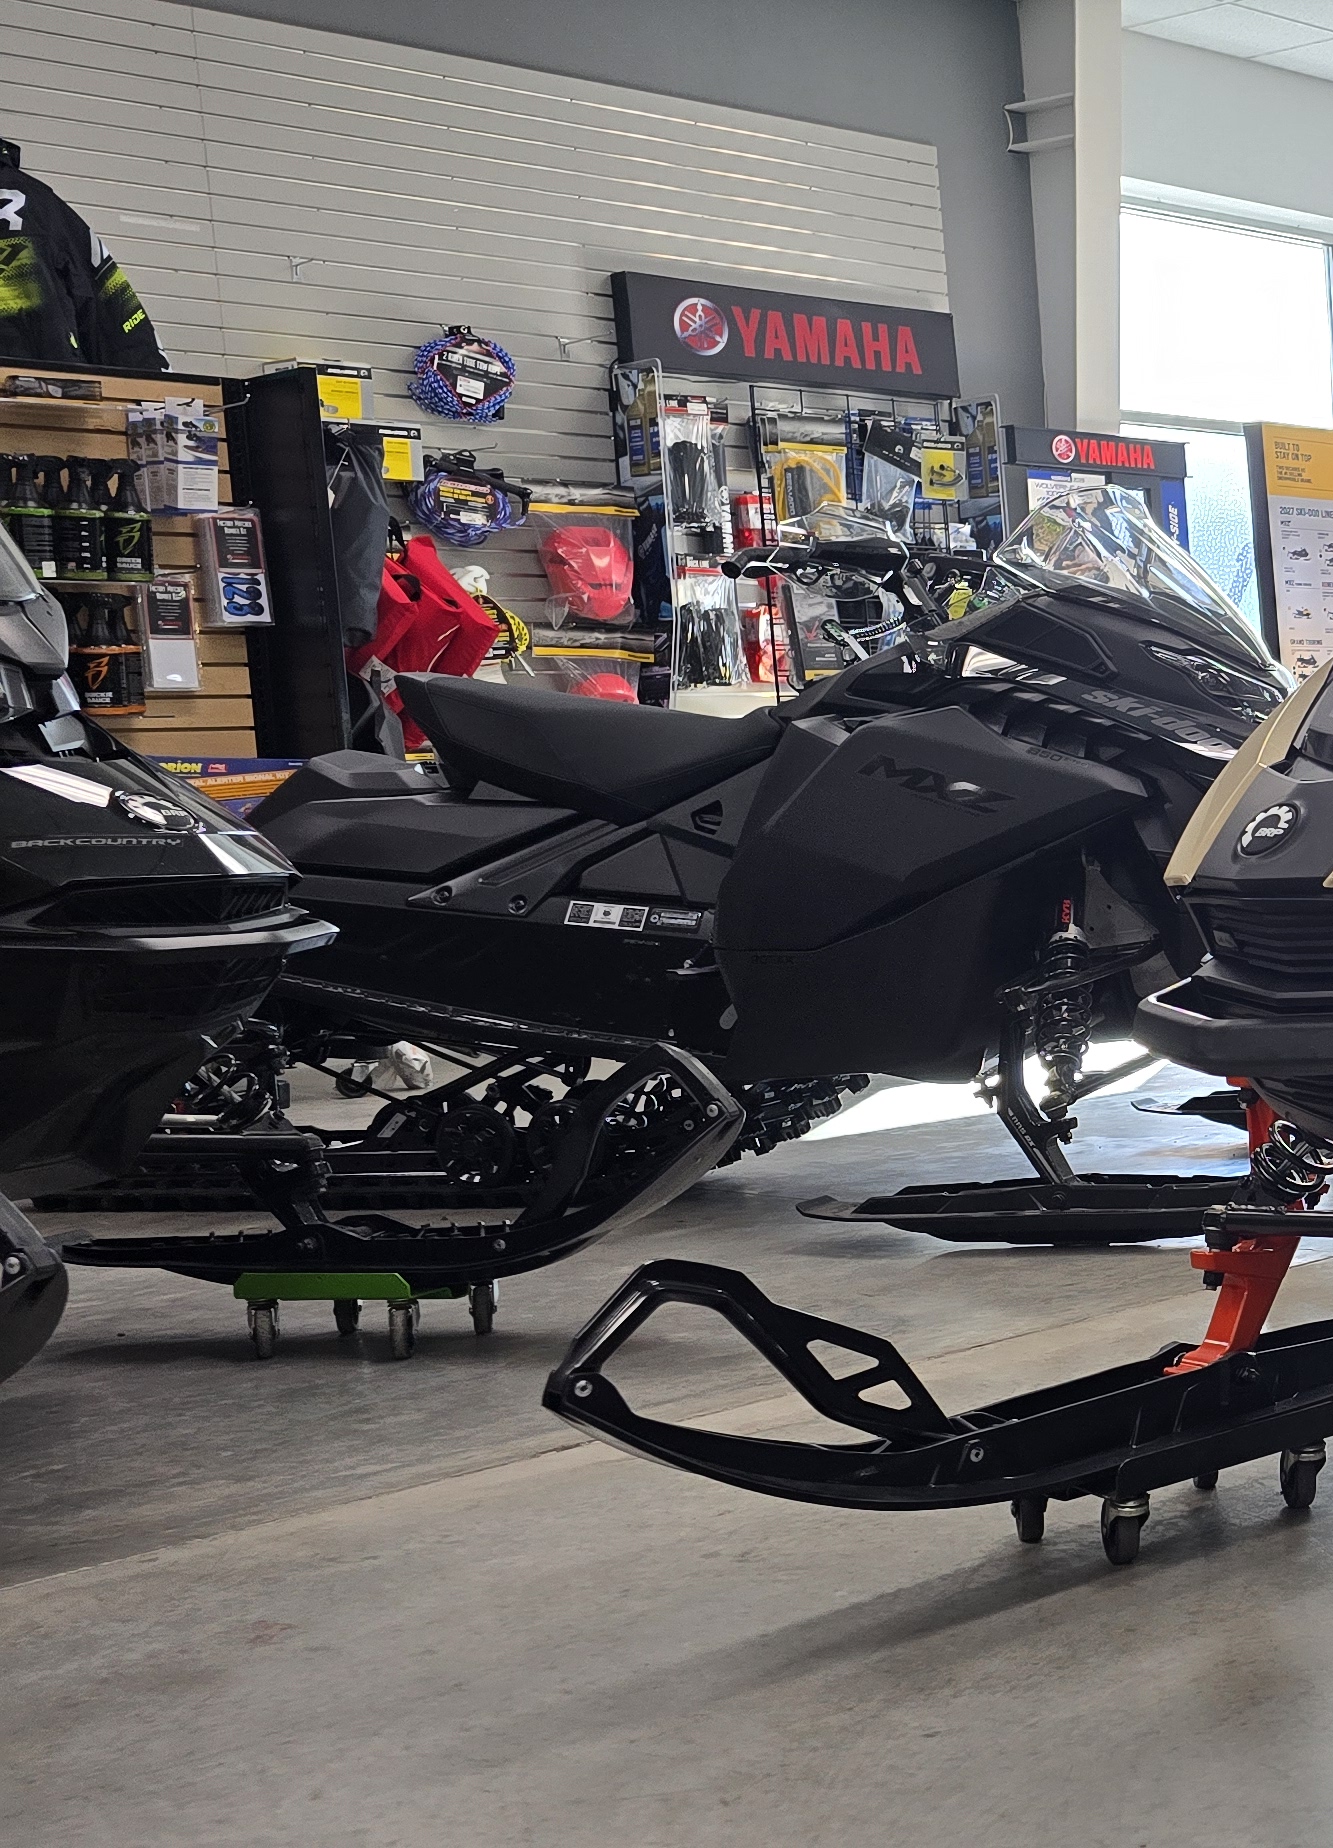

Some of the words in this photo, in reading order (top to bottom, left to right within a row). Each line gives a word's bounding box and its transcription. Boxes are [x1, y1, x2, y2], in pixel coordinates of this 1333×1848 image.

[122, 309, 146, 333] RIDE
[731, 306, 922, 375] YAMAHA
[1075, 438, 1155, 469] YAMAHA
[1274, 441, 1291, 452] BUILT
[1292, 444, 1300, 452] TO
[1275, 451, 1291, 461] STAY
[1292, 453, 1300, 461] ON
[1300, 454, 1312, 463] TOP
[1081, 690, 1240, 752] ski-doo
[857, 754, 1017, 815] MXZ
[11, 837, 183, 849] BACKCOUNTRY
[1254, 827, 1285, 838] BRP
